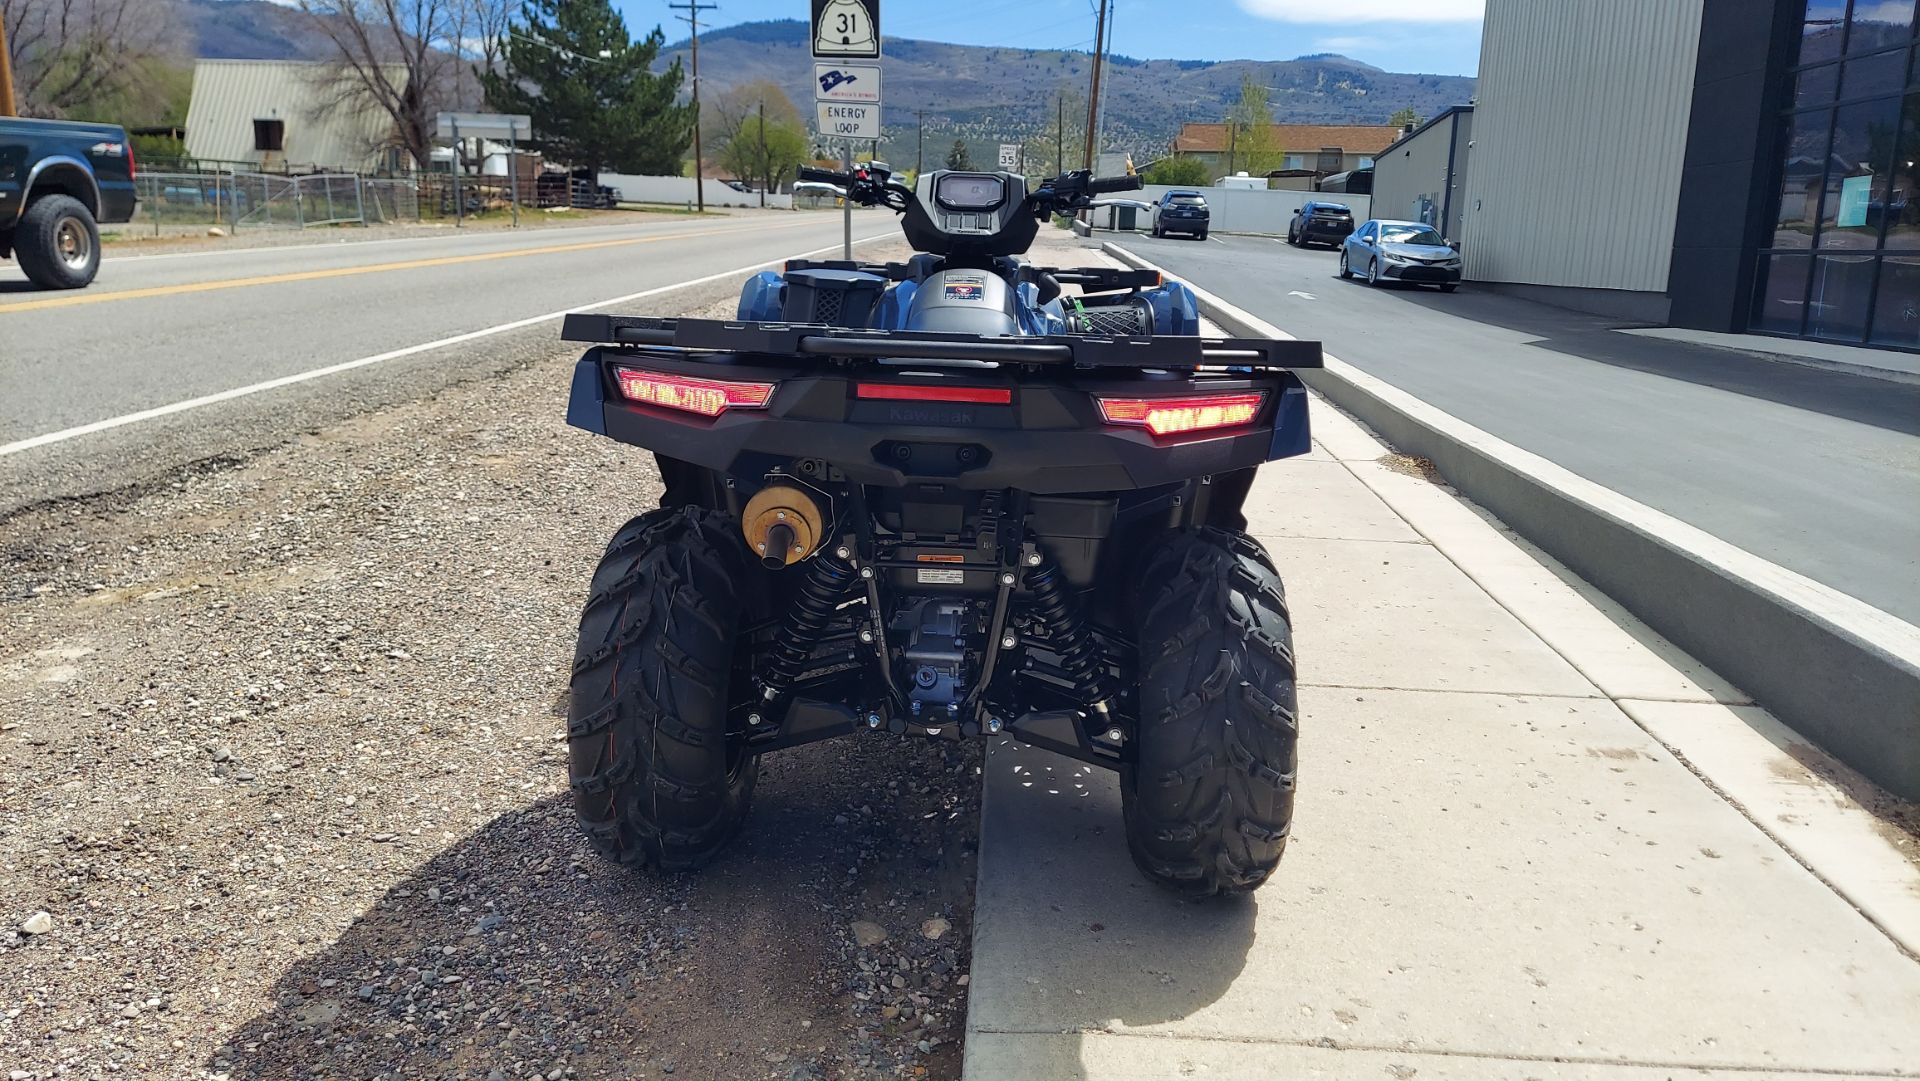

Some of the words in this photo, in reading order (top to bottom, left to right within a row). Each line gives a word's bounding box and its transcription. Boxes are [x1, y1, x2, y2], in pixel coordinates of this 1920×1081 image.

[836, 13, 856, 33] 31
[828, 106, 866, 118] ENERGY
[835, 123, 859, 133] LOOP
[1000, 155, 1015, 165] 35
[889, 407, 976, 424] Kawasak
